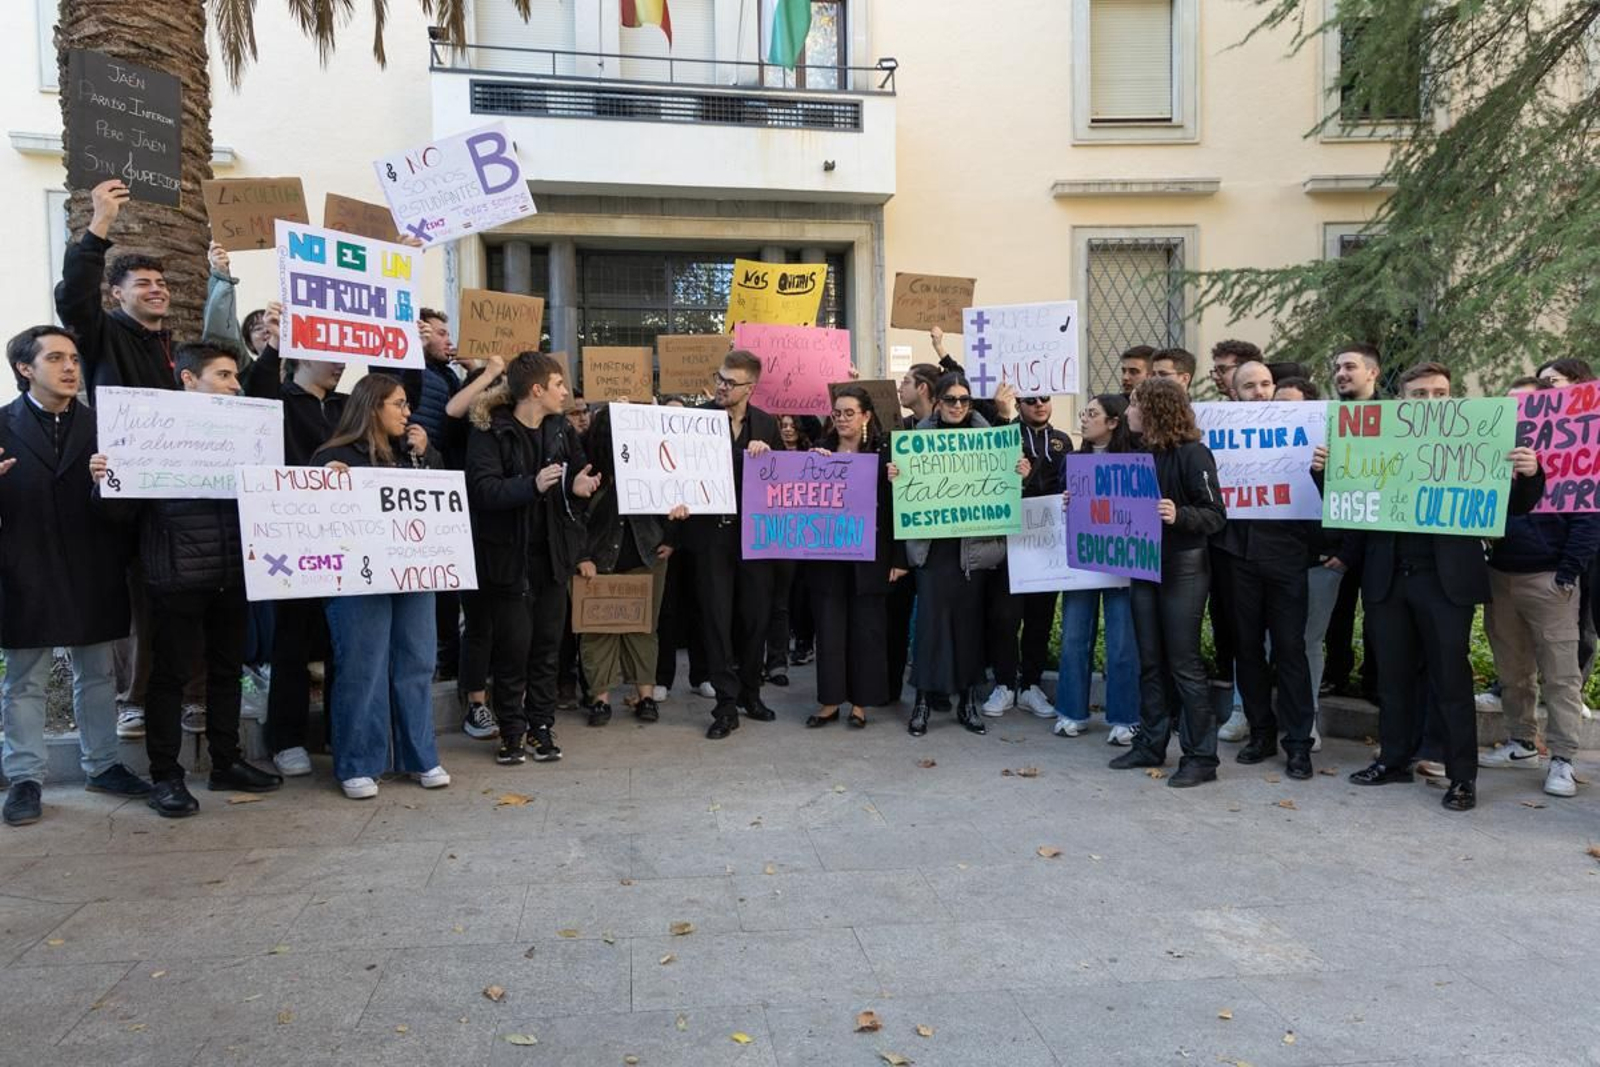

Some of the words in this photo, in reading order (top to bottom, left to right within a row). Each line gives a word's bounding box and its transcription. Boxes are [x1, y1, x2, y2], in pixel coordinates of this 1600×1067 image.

[107, 64, 145, 90] JAÉN
[96, 120, 124, 141] PERO
[84, 145, 116, 175] SIN
[405, 147, 443, 174] NO
[465, 131, 520, 195] B
[288, 231, 326, 264] NO
[336, 241, 366, 272] ES
[382, 250, 412, 281] UN
[738, 269, 768, 290] NOS
[290, 272, 387, 319] CAPRICHO
[470, 299, 493, 322] NO
[495, 302, 518, 321] HAY
[291, 314, 408, 360] NECESIDAD
[108, 404, 176, 430] Mucho
[1525, 391, 1563, 418] UN
[618, 409, 656, 432] SIN
[1339, 404, 1382, 438] NO
[1394, 400, 1470, 438] SOMOS
[1477, 404, 1504, 438] el
[1515, 414, 1600, 451] BAST
[895, 428, 1020, 455] CONSERVATORIO
[1201, 426, 1309, 450] ULTURA
[633, 439, 678, 473] NO
[684, 438, 723, 471] HAY
[760, 457, 779, 481] el
[800, 456, 853, 481] Arte
[910, 452, 1008, 476] ABANDONADO
[1417, 443, 1489, 484] SOMOS
[1490, 450, 1508, 482] la
[138, 472, 236, 490] DESCAMP
[766, 481, 847, 508] MERECE
[898, 473, 1018, 502] talento
[1069, 470, 1091, 497] sin
[271, 501, 320, 516] toca
[330, 499, 362, 514] con
[380, 486, 463, 513] BASTA
[1329, 490, 1382, 524] BASE
[1391, 489, 1409, 504] de
[1415, 486, 1498, 529] CULTURA
[900, 503, 1012, 527] DESPERDICIADO
[1090, 498, 1110, 524] NO
[1112, 501, 1132, 536] hay
[1390, 506, 1408, 523] la
[253, 519, 386, 540] INSTRUMENTOS
[392, 519, 426, 543] NO
[298, 554, 346, 572] CSMJ
